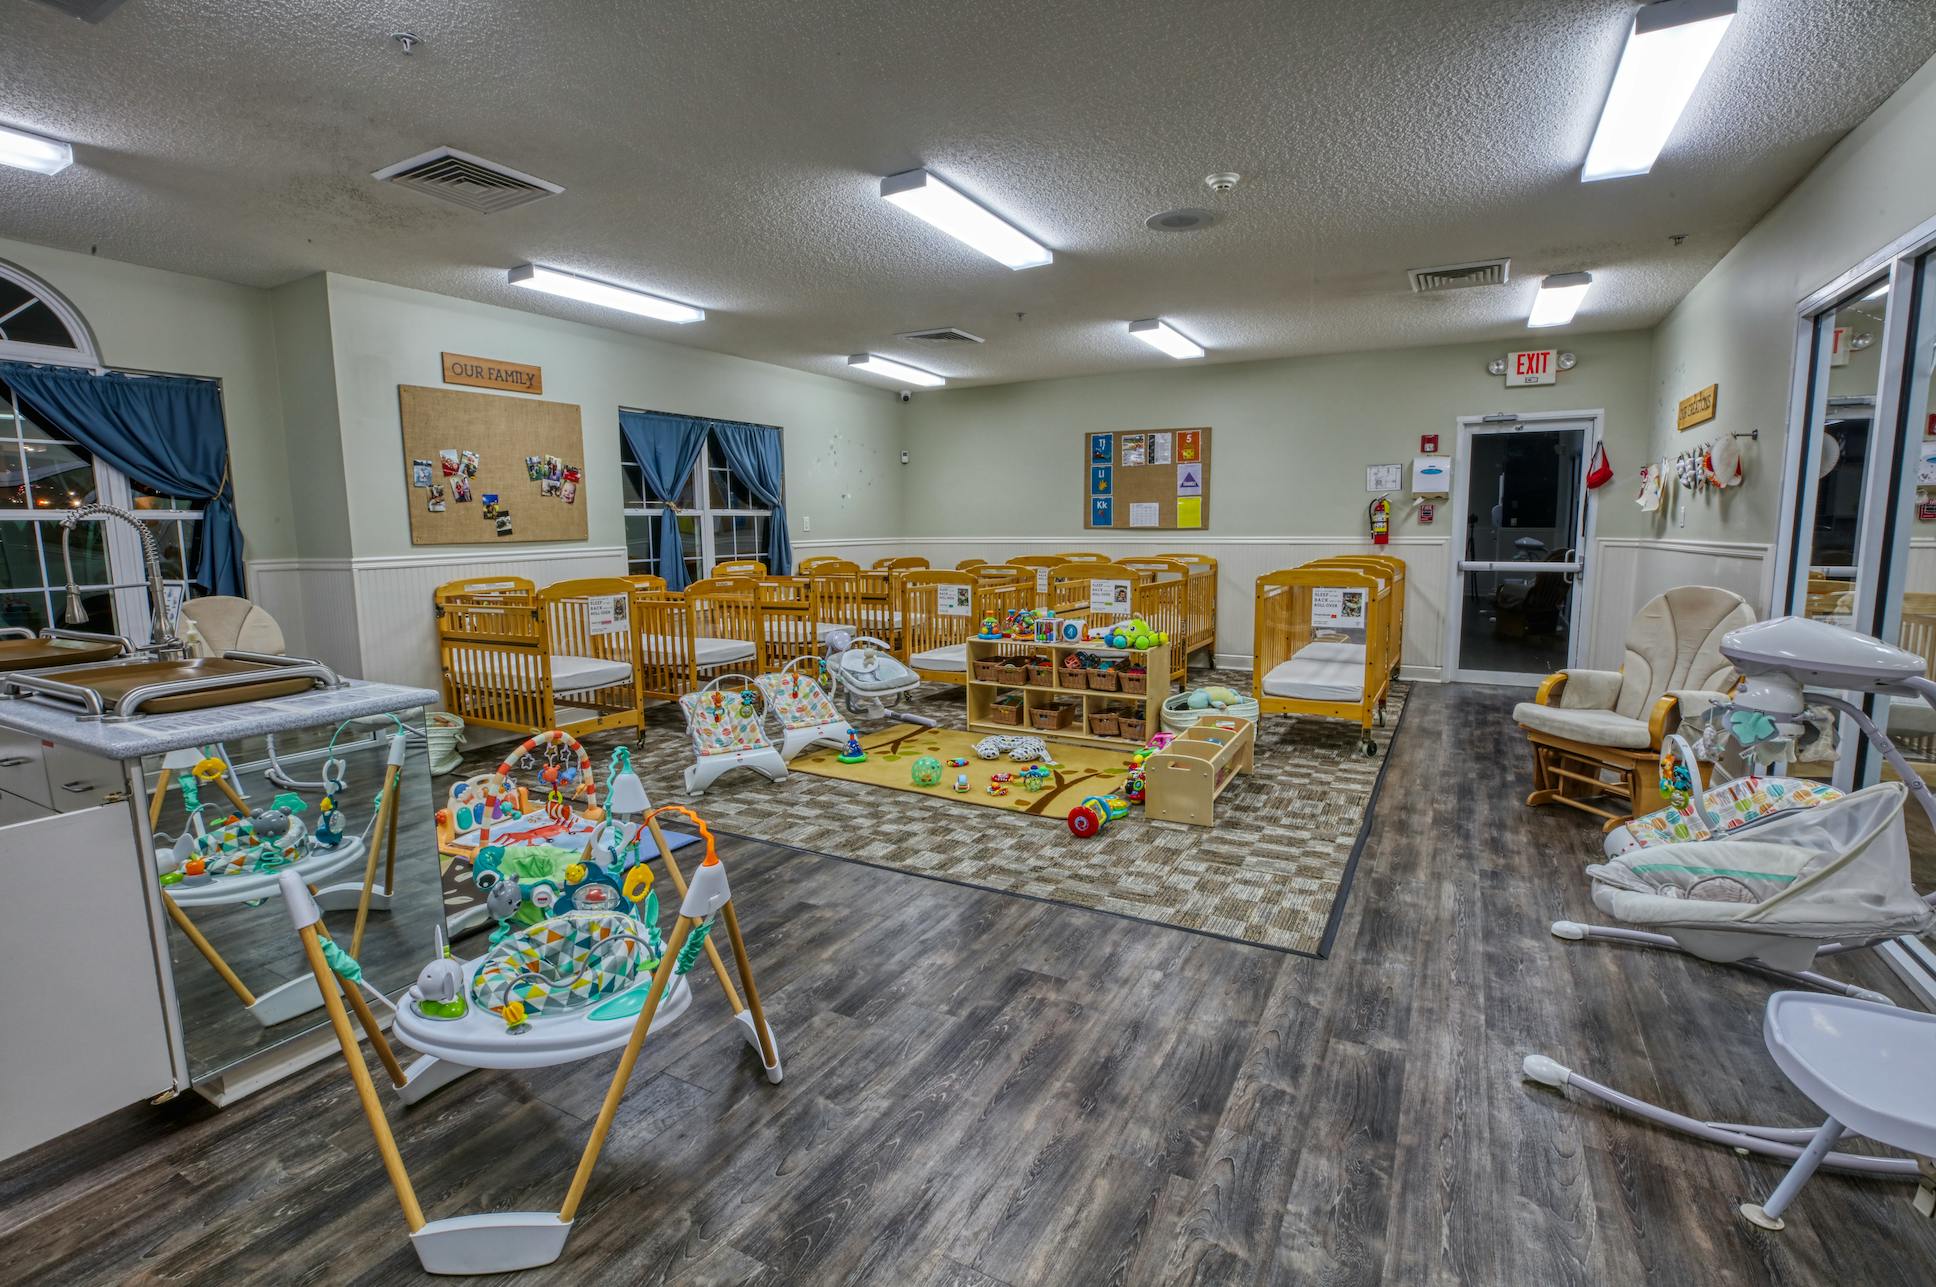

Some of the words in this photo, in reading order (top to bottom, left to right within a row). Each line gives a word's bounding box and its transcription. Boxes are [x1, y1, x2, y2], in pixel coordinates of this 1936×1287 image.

[451, 362, 484, 378] OUR
[489, 368, 535, 388] FAMILY
[1516, 352, 1550, 375] EXIT
[1096, 500, 1108, 509] Kk
